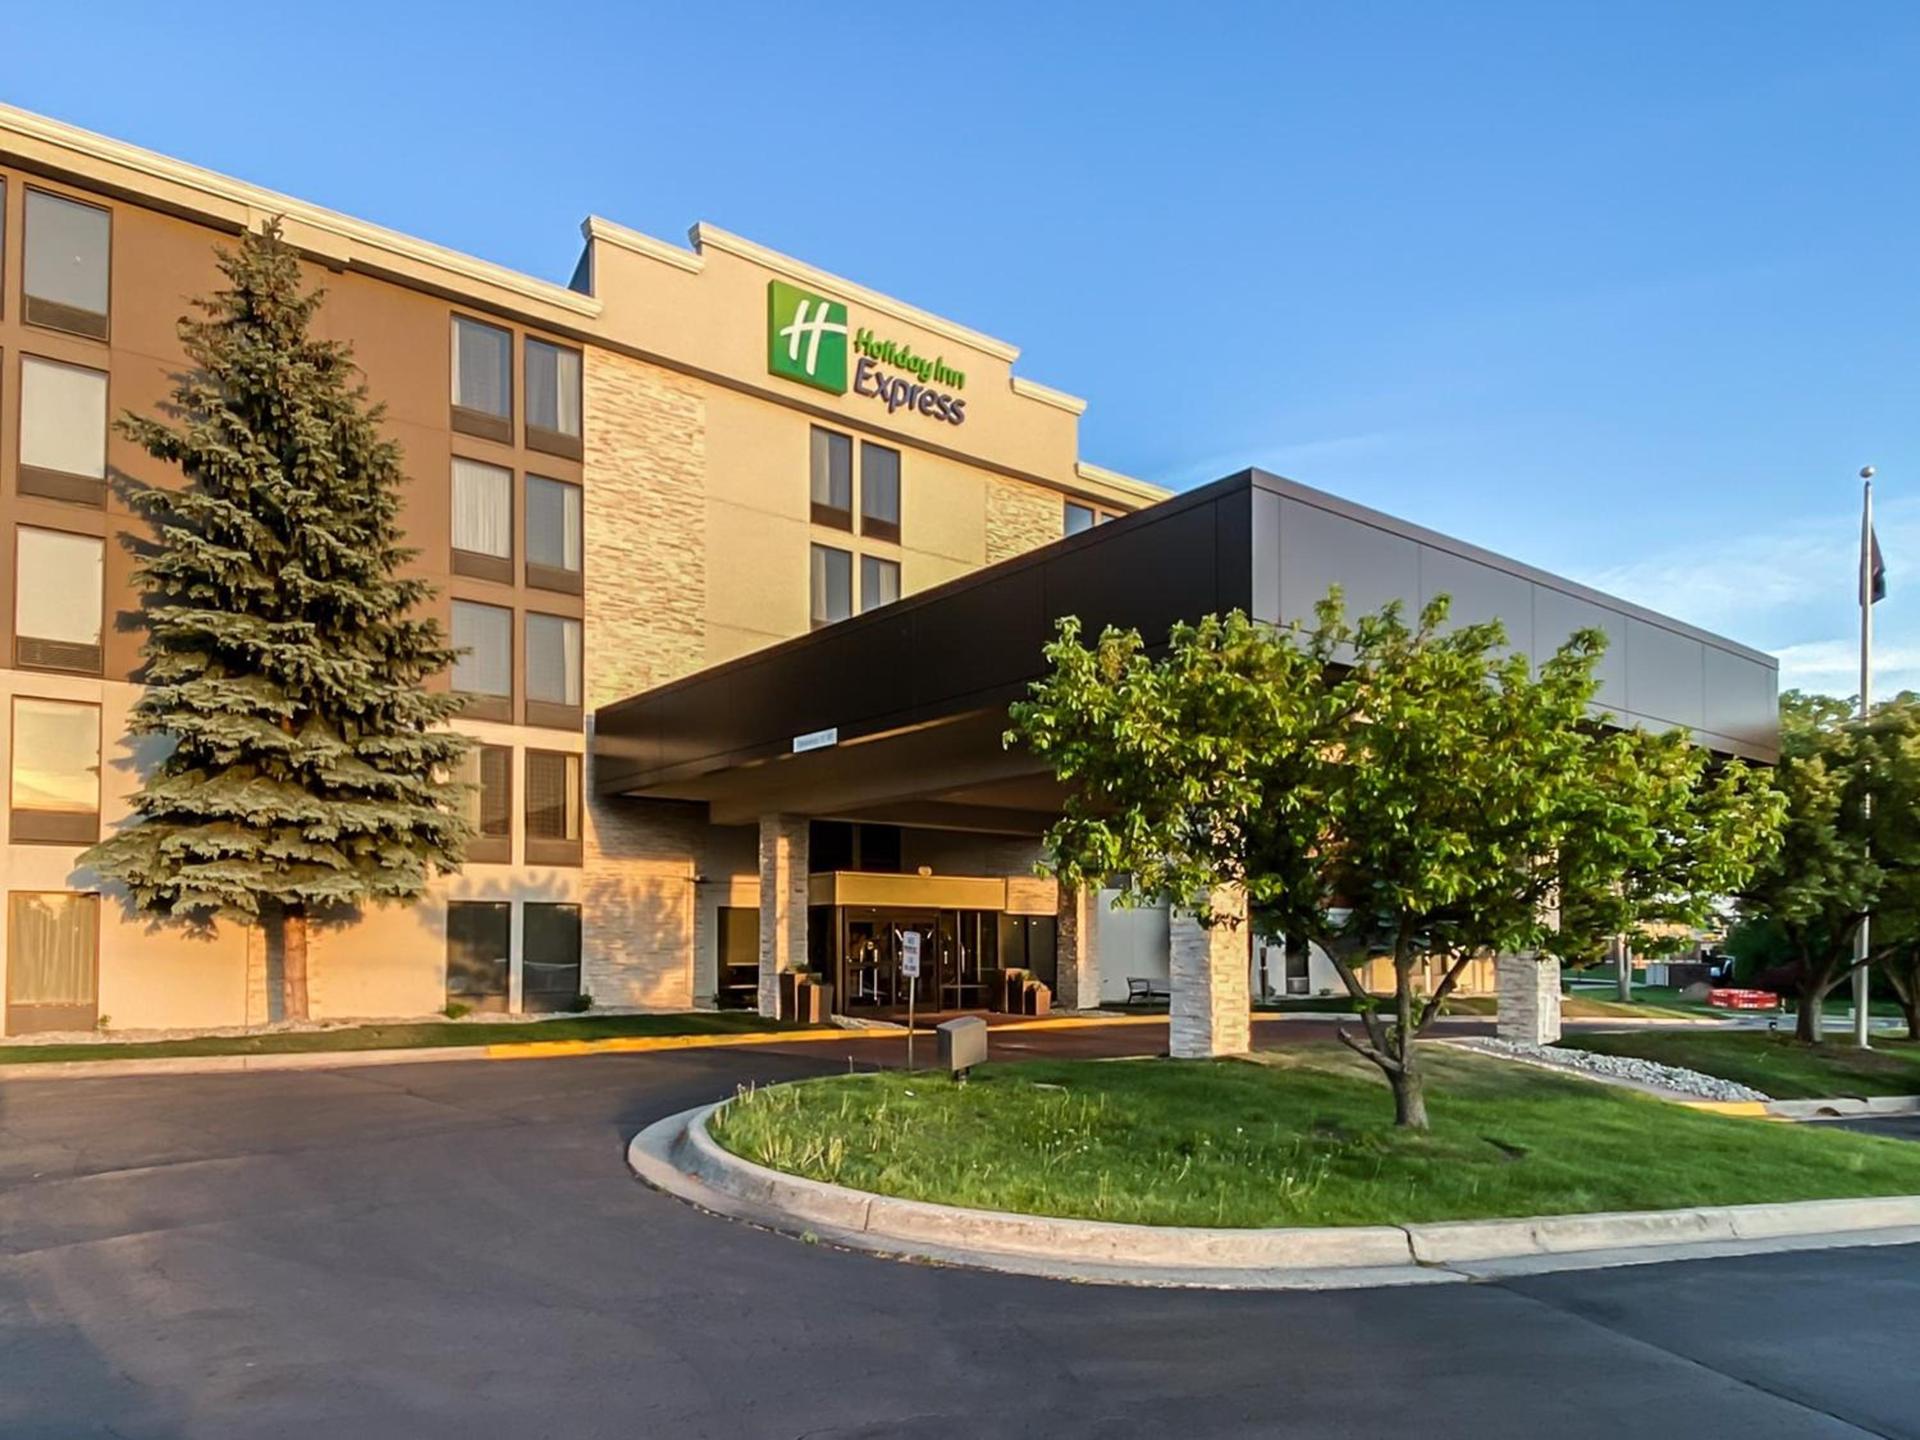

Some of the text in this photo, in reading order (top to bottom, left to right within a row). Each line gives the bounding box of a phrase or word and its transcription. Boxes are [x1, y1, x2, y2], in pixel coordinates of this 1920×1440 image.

[853, 327, 966, 390] Holiday Inn
[853, 357, 966, 426] Express
